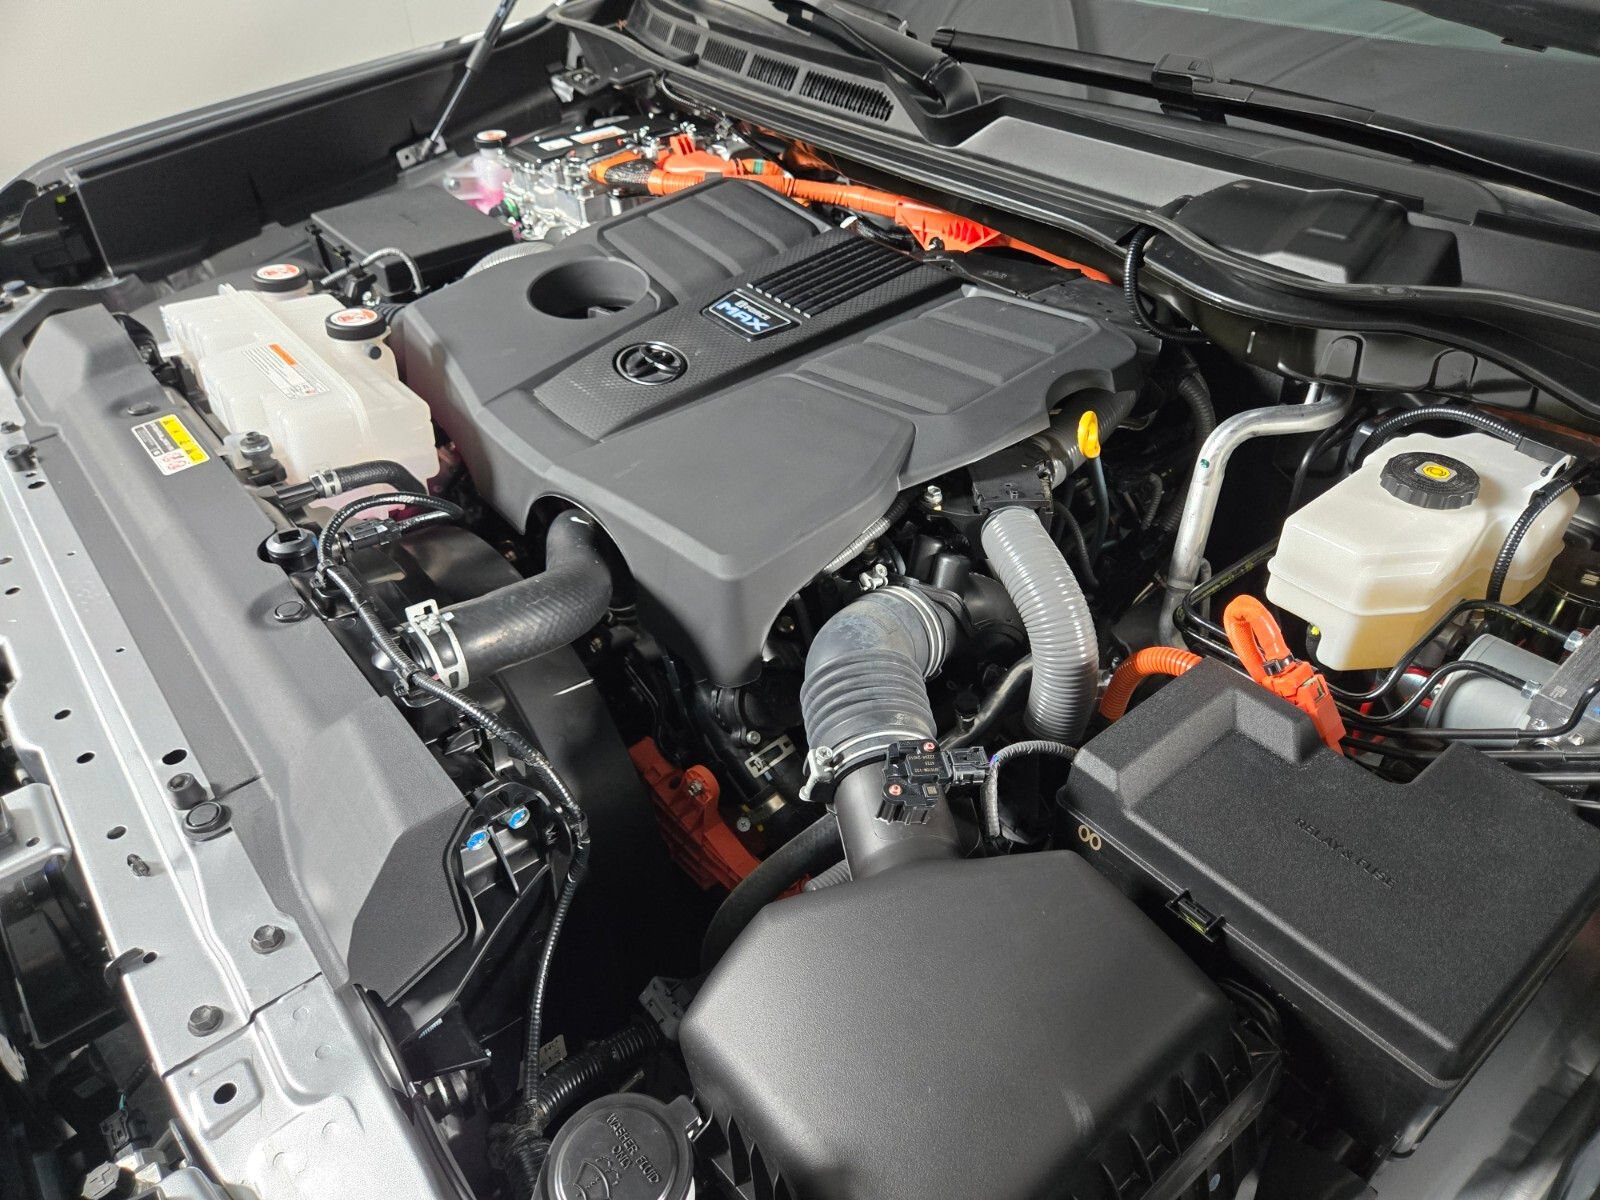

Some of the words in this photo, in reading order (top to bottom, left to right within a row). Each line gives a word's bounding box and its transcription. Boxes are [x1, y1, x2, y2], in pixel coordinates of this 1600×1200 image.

[715, 300, 770, 332] MAX
[1294, 818, 1343, 851] RELAY
[1354, 858, 1396, 889] FUSE
[606, 1112, 640, 1156] WASHER
[635, 1154, 660, 1184] FLUID
[611, 1144, 632, 1171] ONLY
